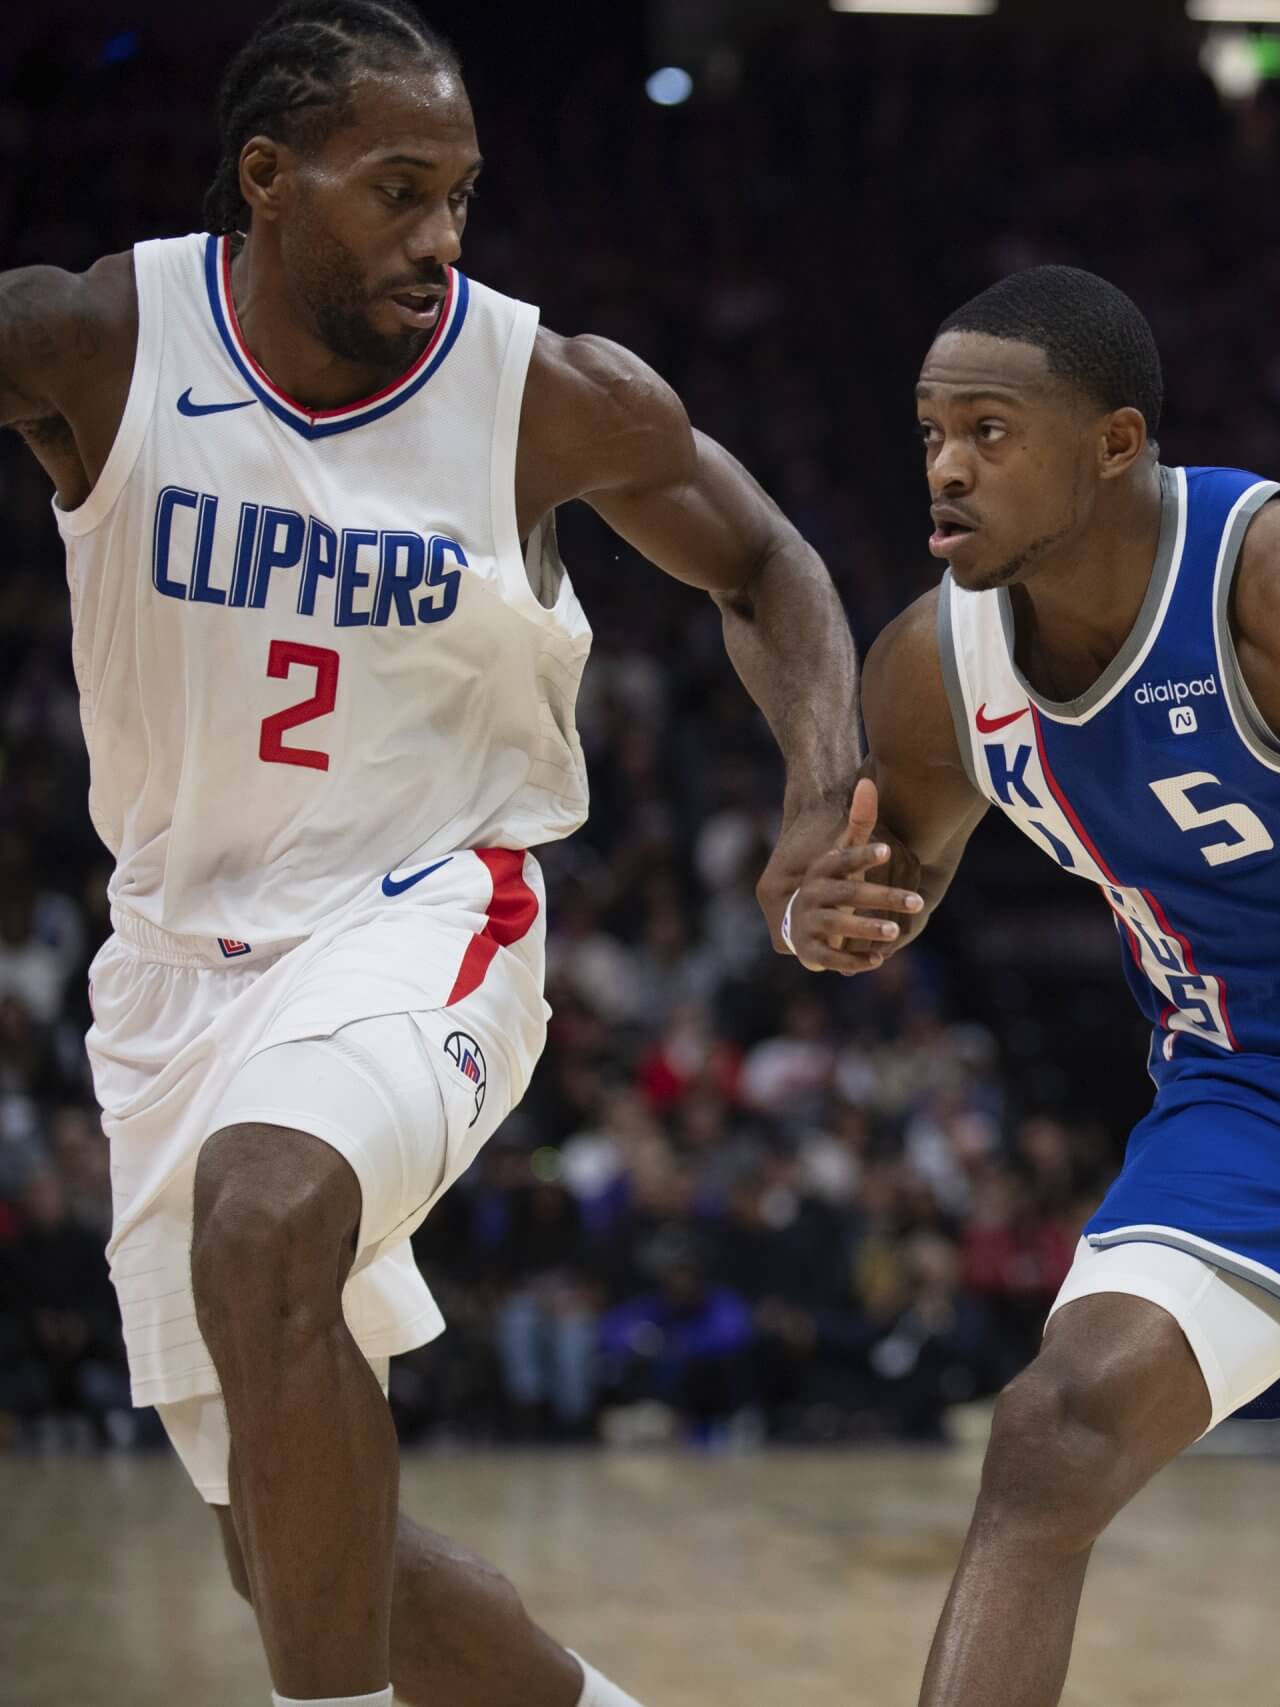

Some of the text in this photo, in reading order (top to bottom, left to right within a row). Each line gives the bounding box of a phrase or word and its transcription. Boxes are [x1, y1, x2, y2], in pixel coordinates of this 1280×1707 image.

[152, 485, 469, 628] CLIPPERS
[259, 640, 340, 772] 2
[1134, 674, 1217, 706] dialpad
[1148, 771, 1274, 867] 5
